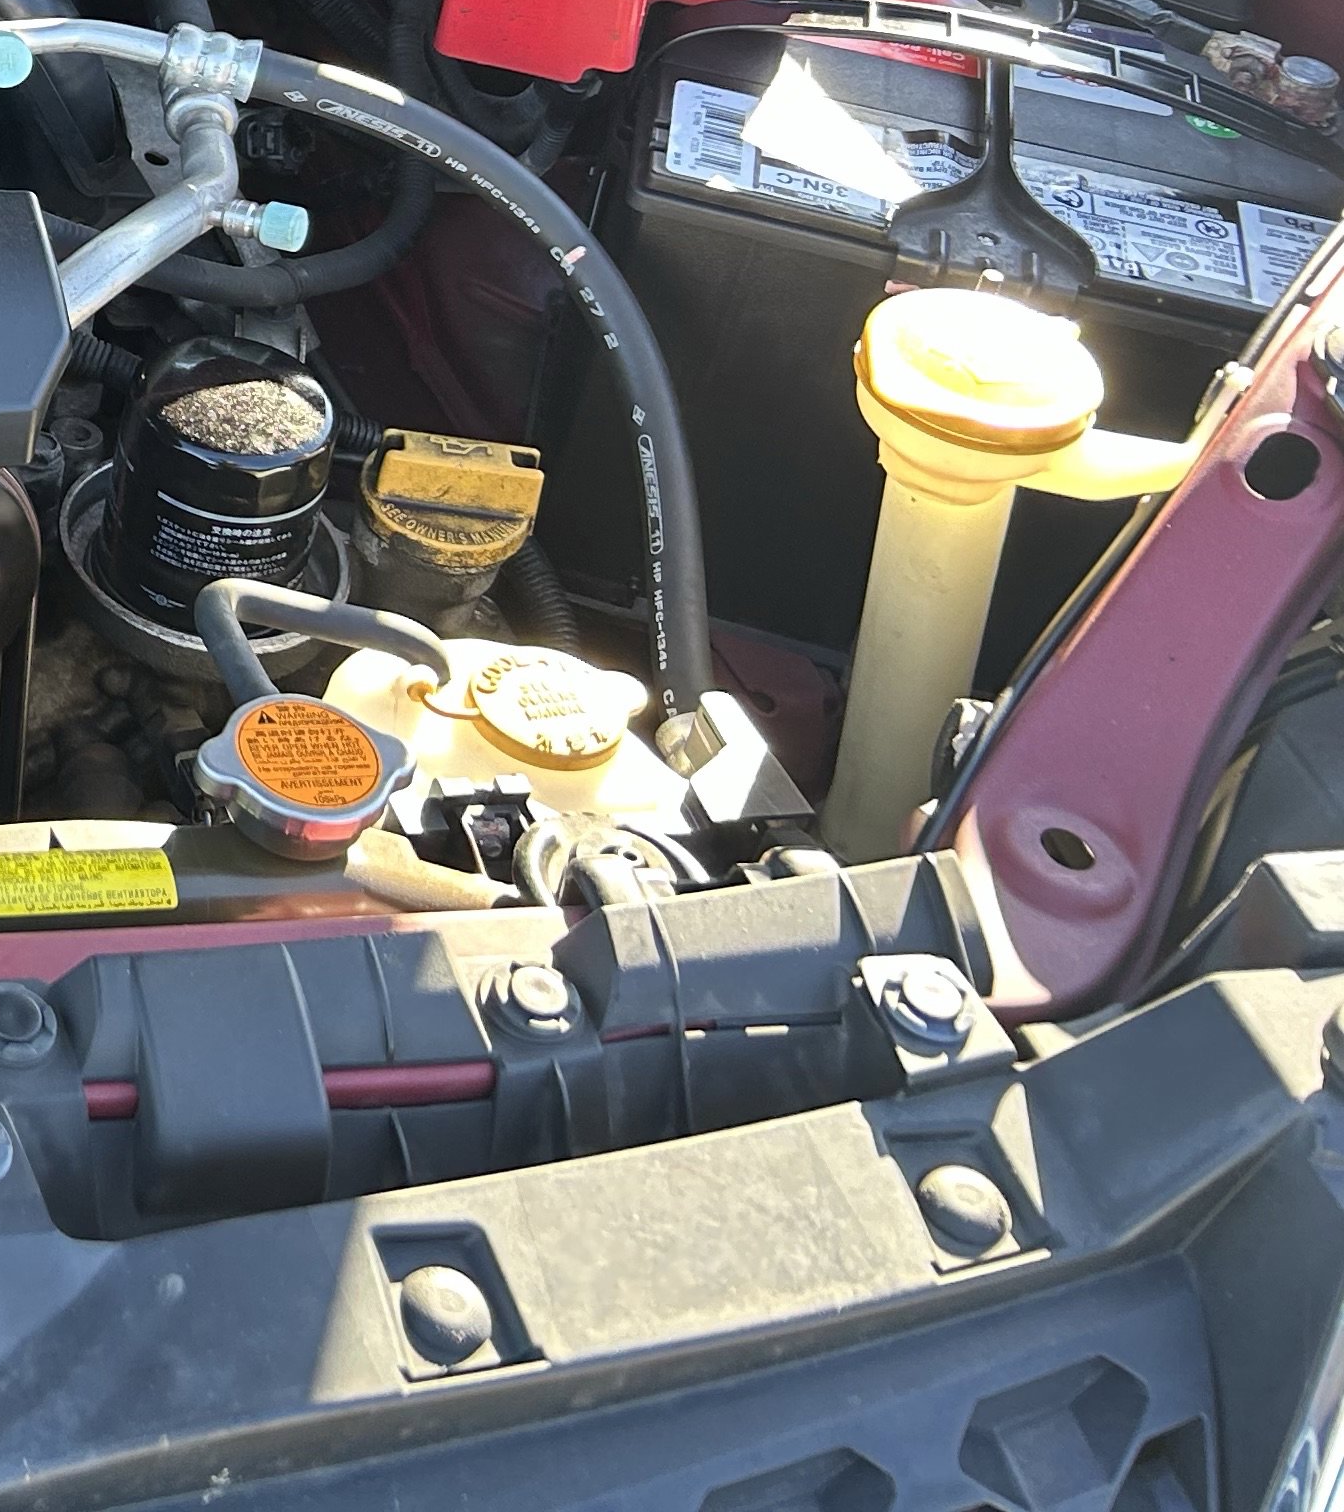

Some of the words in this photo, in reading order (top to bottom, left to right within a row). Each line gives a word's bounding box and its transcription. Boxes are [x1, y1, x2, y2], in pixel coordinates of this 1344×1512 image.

[445, 156, 468, 173] HP
[578, 286, 605, 317] 27
[380, 502, 408, 523] SEE
[405, 519, 468, 545] OWNER'S
[469, 520, 520, 545] MANUAL
[652, 561, 662, 583] HP
[275, 711, 329, 720] WARNING
[280, 778, 363, 789] AVERTISSEMENT
